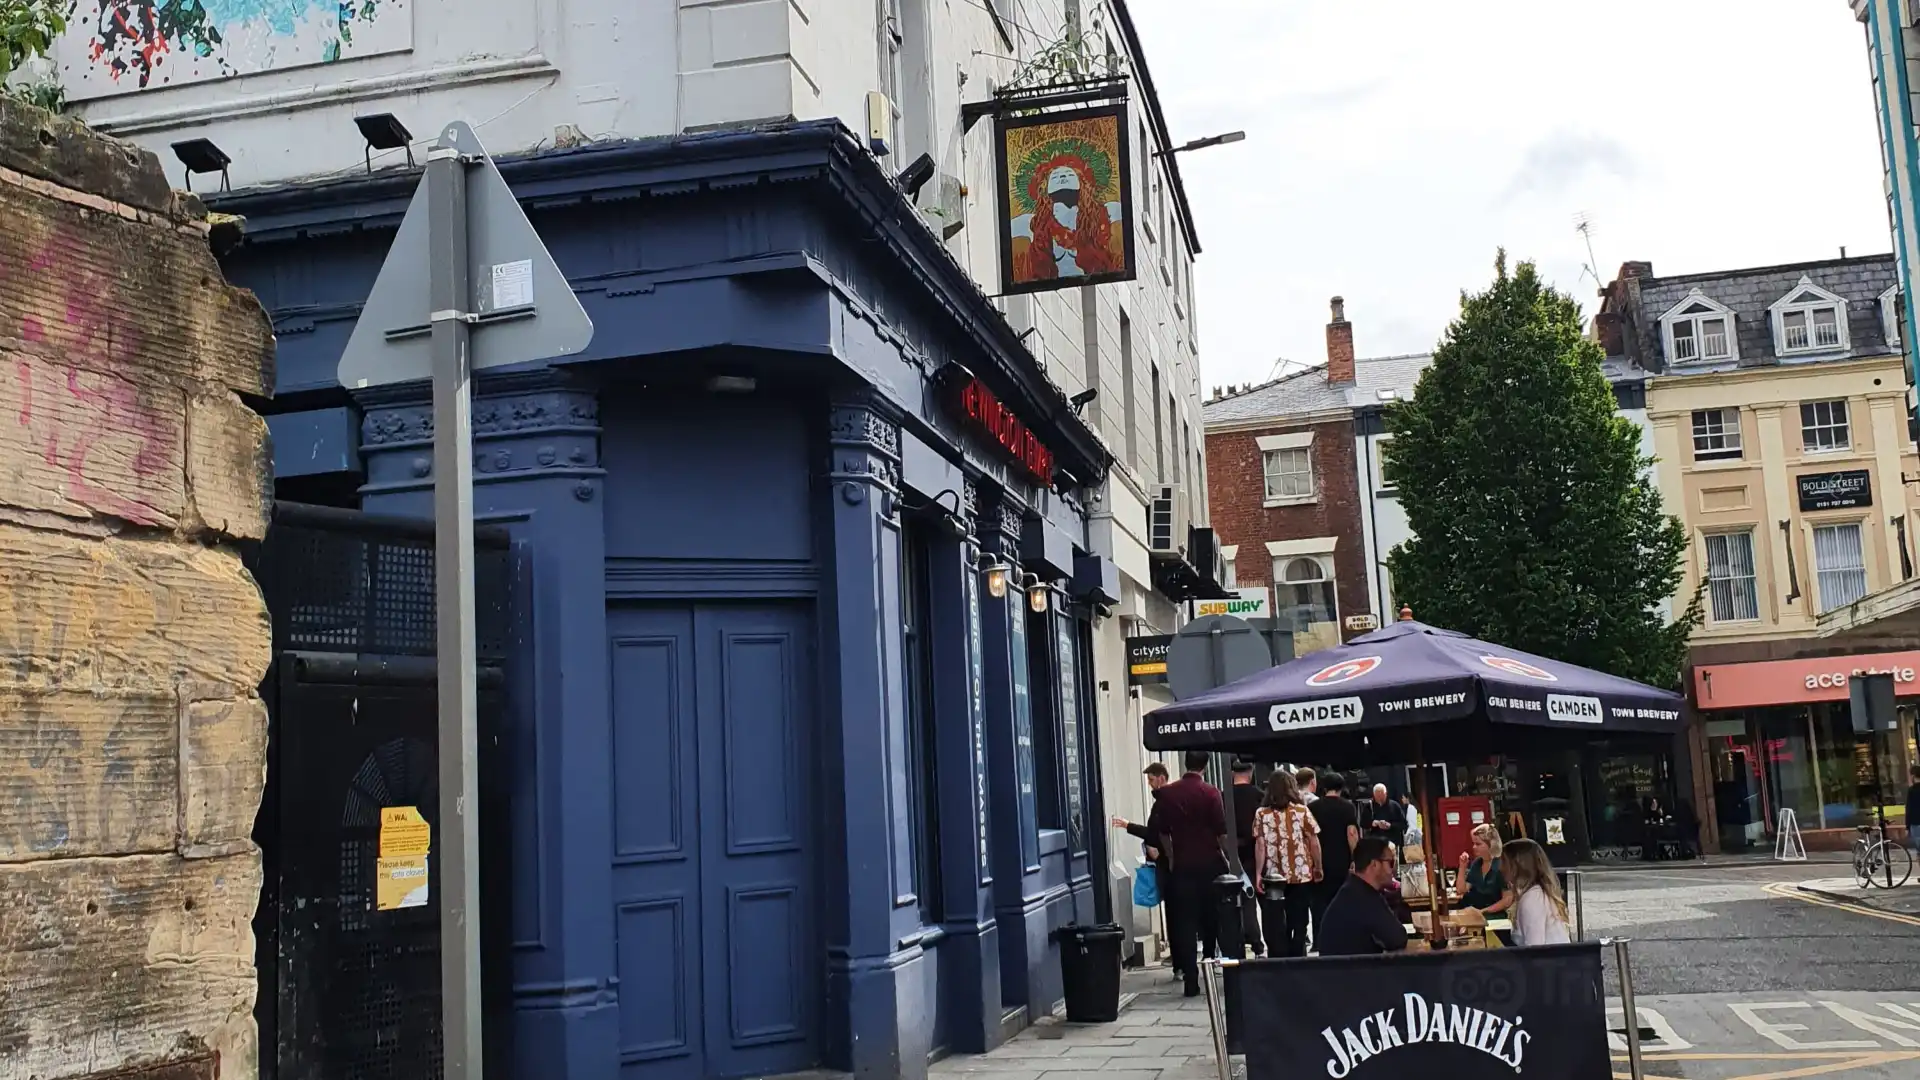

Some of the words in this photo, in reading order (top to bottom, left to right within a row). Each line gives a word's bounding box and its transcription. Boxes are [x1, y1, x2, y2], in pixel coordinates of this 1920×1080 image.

[1802, 481, 1828, 491] BOLD
[1830, 477, 1865, 489] STREET
[969, 577, 979, 655] MUSIC
[1198, 600, 1264, 616] SUBWAY
[1805, 672, 1846, 689] ace
[1868, 665, 1915, 682] te
[1158, 722, 1191, 735] GREAT
[1194, 719, 1223, 731] BEER
[1226, 717, 1256, 729] HERE
[1276, 703, 1356, 724] CAMDEN
[1378, 700, 1411, 713] TOWN
[1414, 692, 1467, 709] BREWERY
[1550, 700, 1597, 717] CAMDEN
[1611, 707, 1635, 718] TOWN
[1637, 709, 1679, 720] BREWERY
[975, 720, 983, 764] THE
[978, 773, 987, 867] MASSES
[1321, 1008, 1404, 1079] JACK
[1403, 992, 1532, 1068] DANIEL'S
